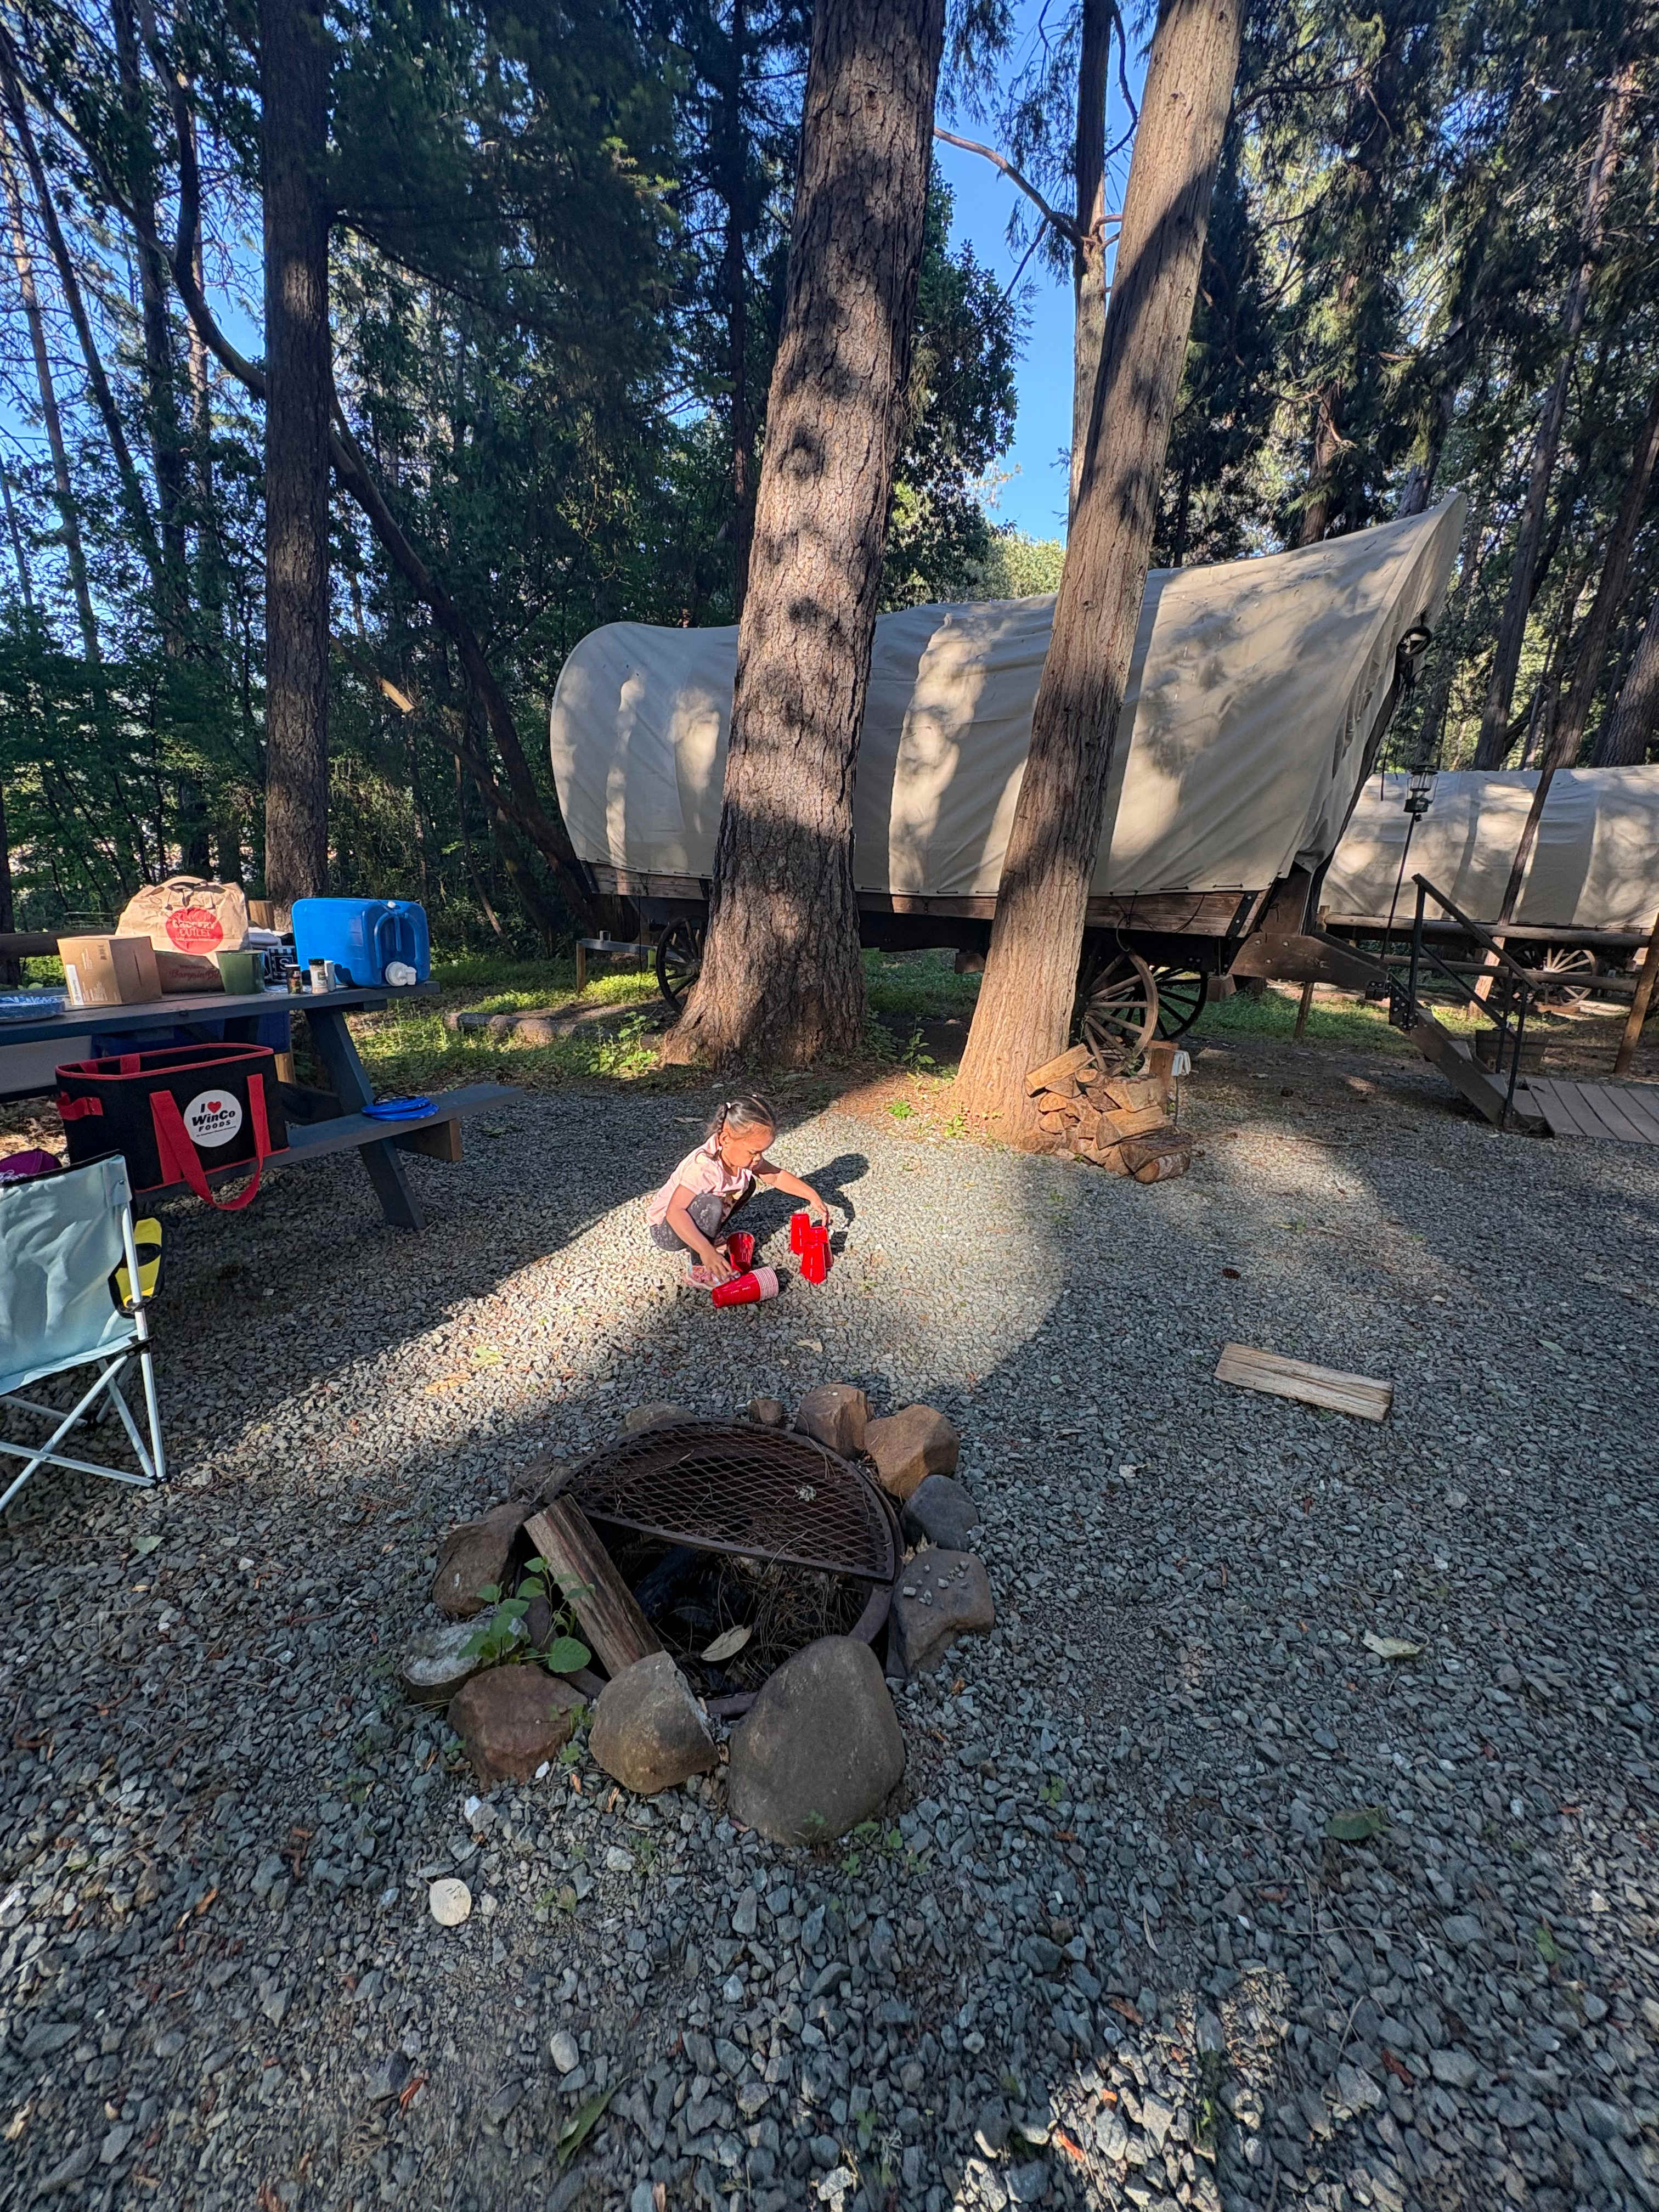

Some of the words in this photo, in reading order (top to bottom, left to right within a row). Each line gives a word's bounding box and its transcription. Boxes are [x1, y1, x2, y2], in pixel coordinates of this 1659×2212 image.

[180, 928, 210, 937] OUTLET
[192, 1110, 236, 1126] WinCo
[199, 1120, 231, 1132] FOODS
